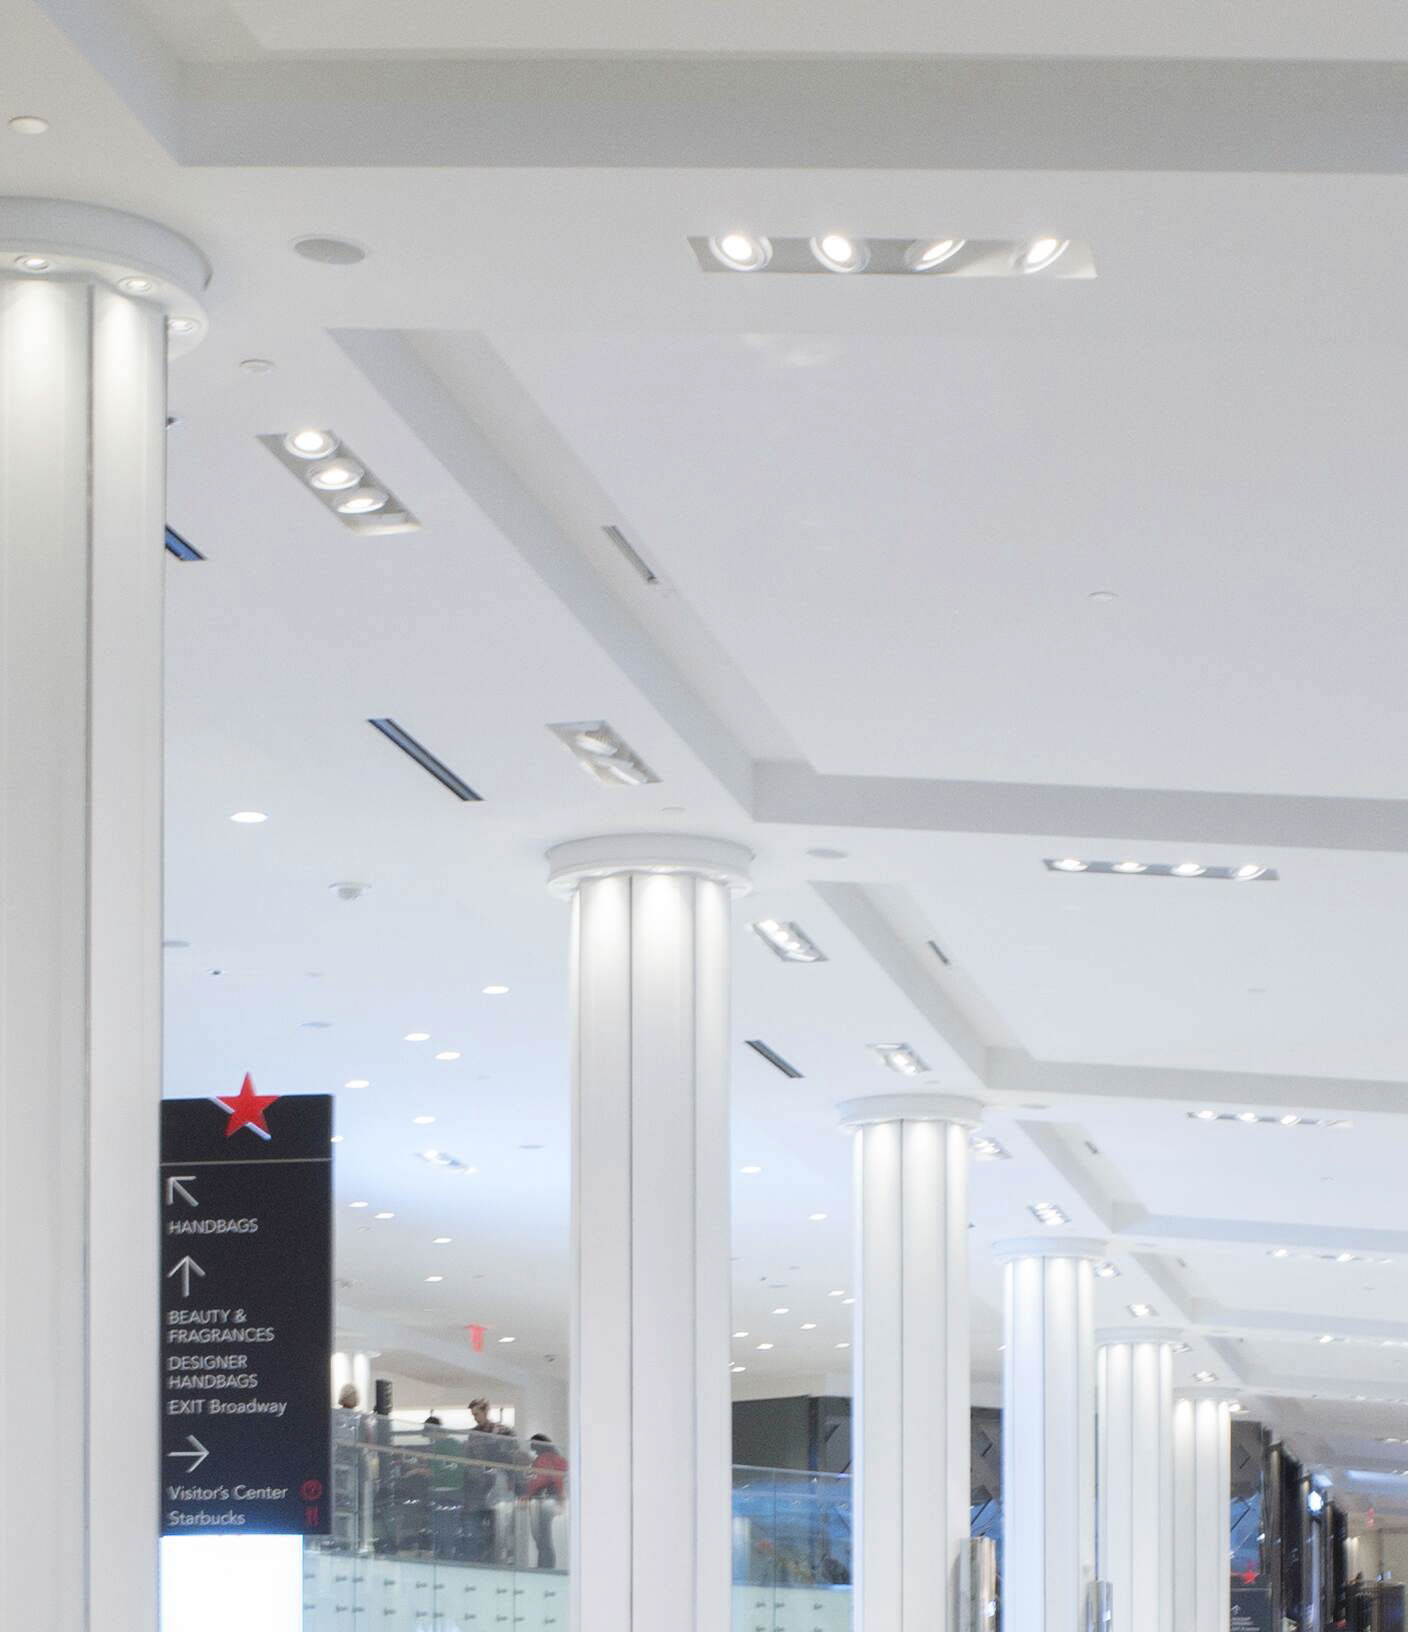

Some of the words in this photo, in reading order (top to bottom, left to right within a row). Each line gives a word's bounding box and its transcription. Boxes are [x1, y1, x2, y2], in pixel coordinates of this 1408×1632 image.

[169, 1218, 259, 1235] HANDBAGS
[168, 1309, 230, 1325] BEAUTY
[232, 1308, 248, 1324] &
[167, 1327, 276, 1343] FRAGRANCES
[168, 1355, 248, 1371] DESIGNER
[168, 1374, 259, 1390] HANDBAGS
[168, 1399, 206, 1415] EXIT
[209, 1399, 288, 1418] Broadway
[168, 1485, 230, 1500] Visitor's
[234, 1485, 289, 1500] Center
[169, 1510, 246, 1527] Starbucks
